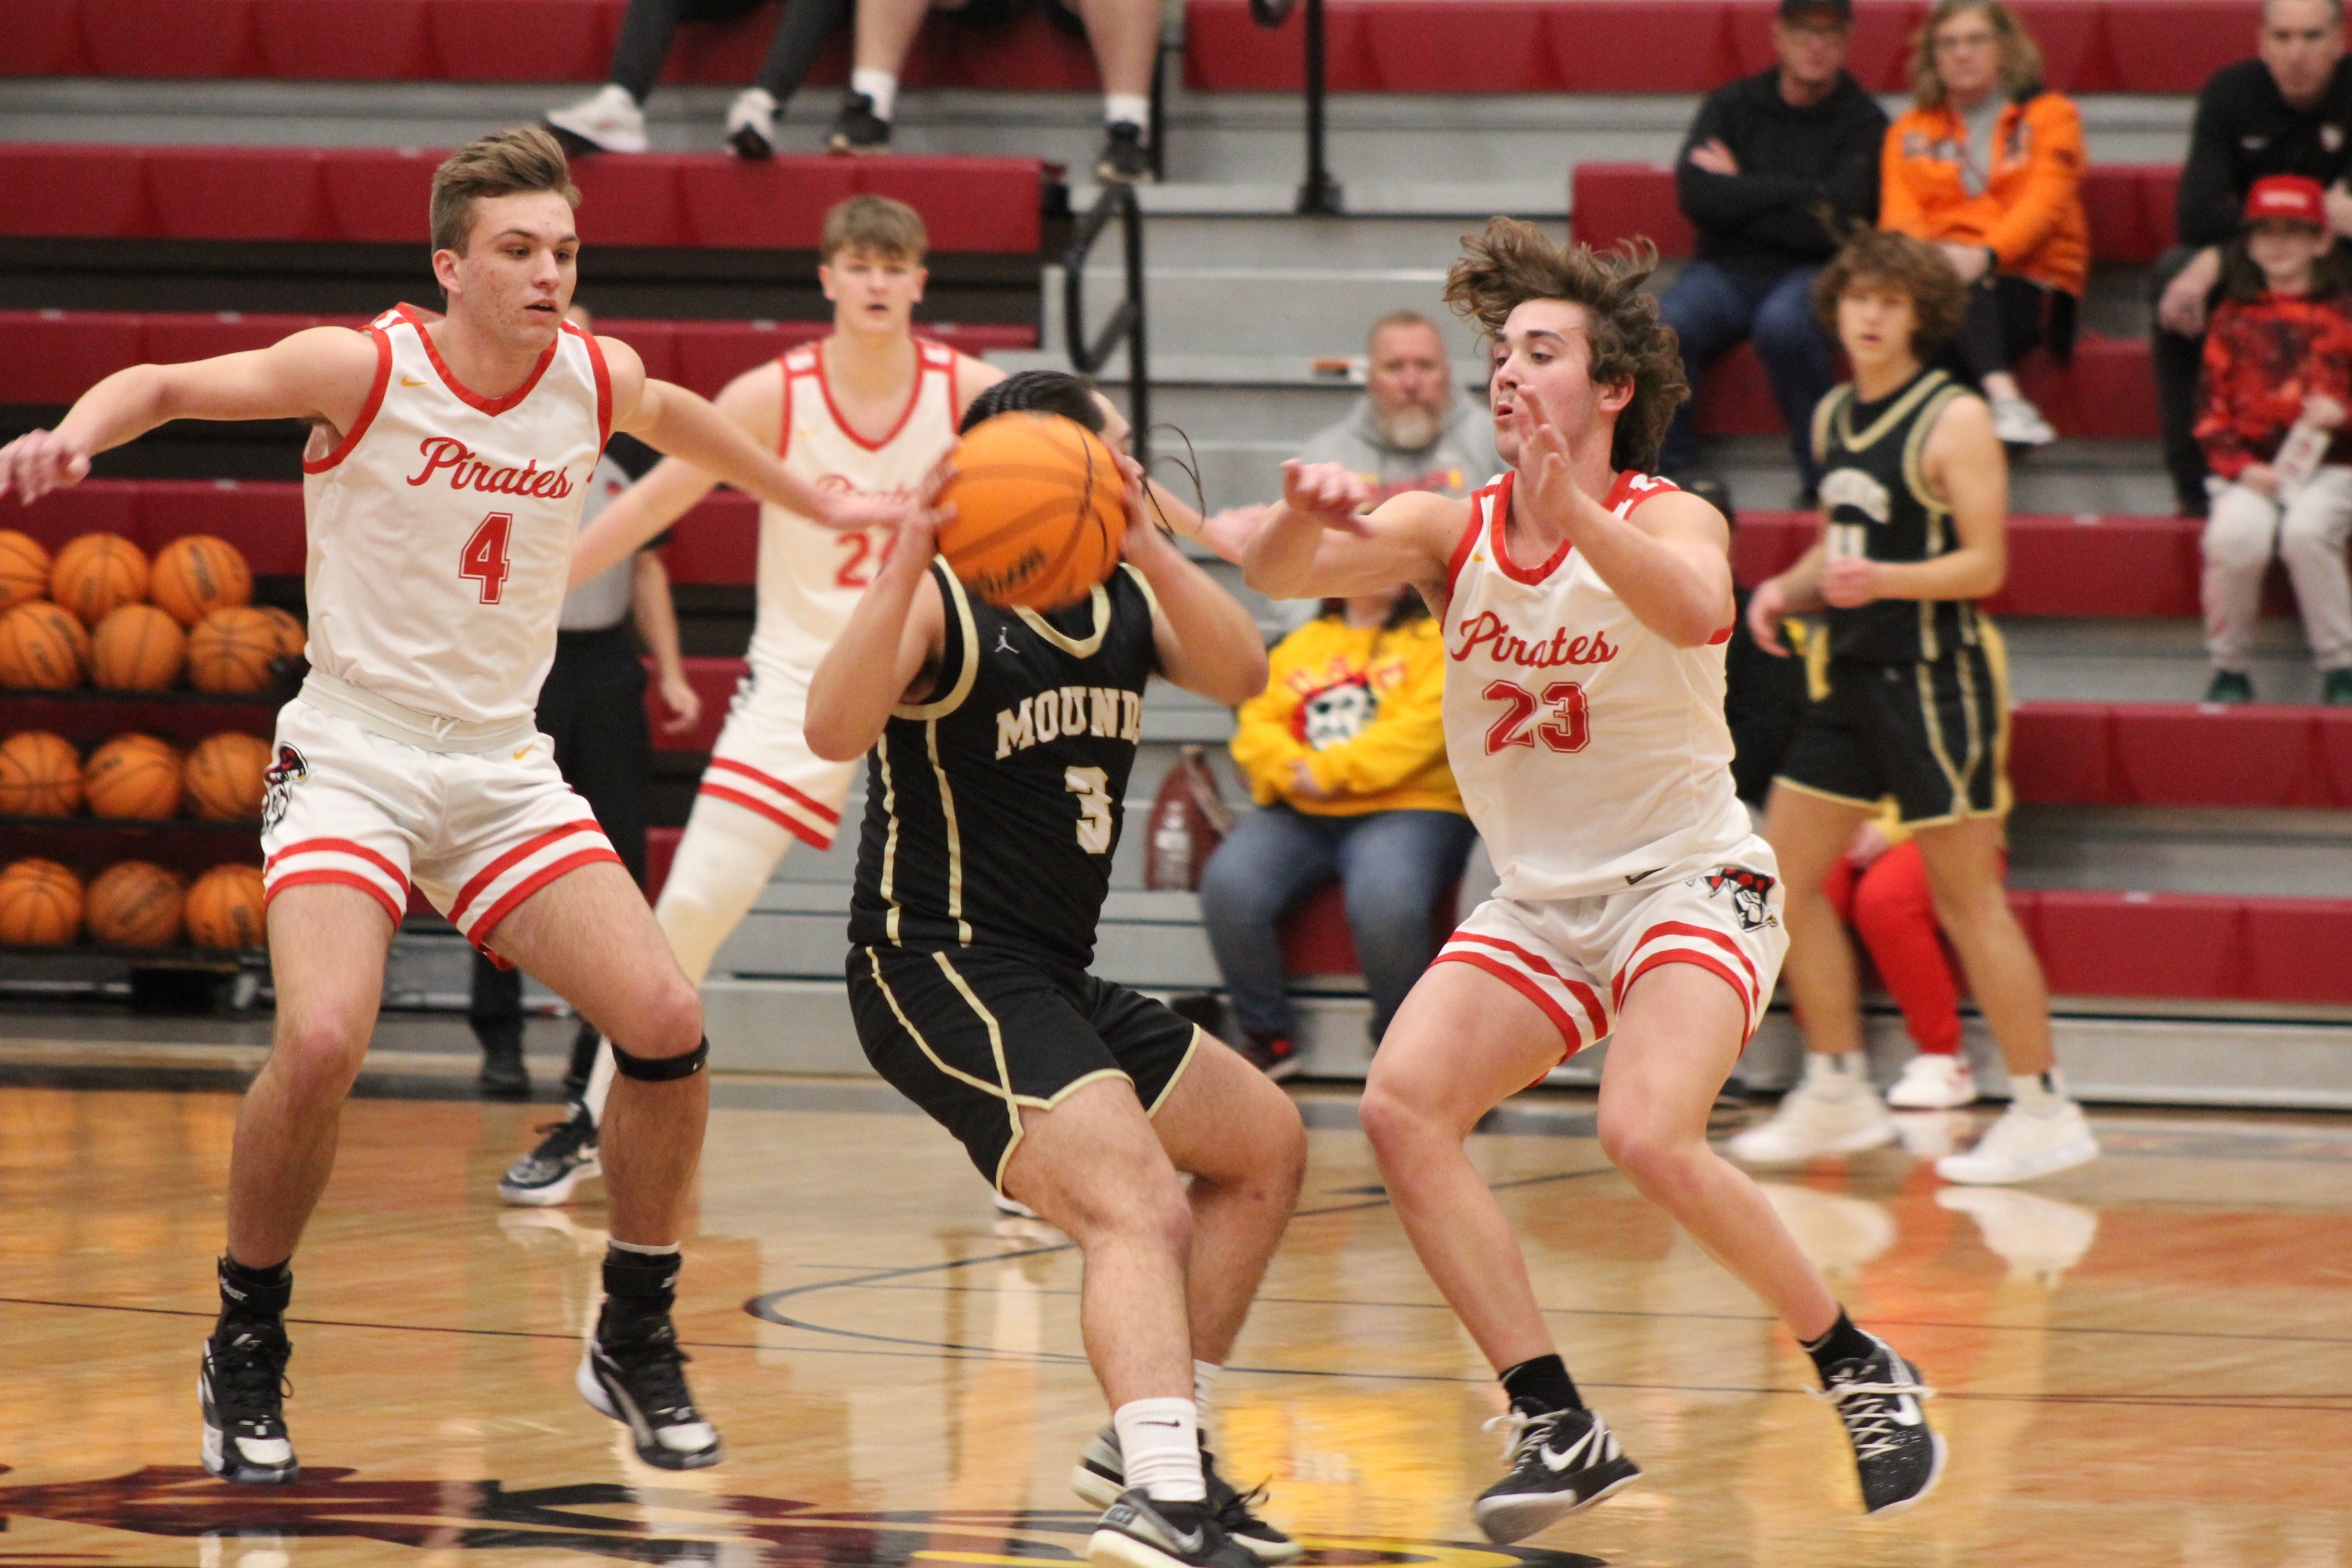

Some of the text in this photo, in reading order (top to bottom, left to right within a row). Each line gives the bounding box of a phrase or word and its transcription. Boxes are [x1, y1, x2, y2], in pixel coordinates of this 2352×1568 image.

[407, 437, 573, 500] Pirates
[459, 512, 513, 604] 4
[1450, 610, 1618, 668] Pirates
[1482, 679, 1590, 755] 23
[1064, 766, 1113, 854] 3
